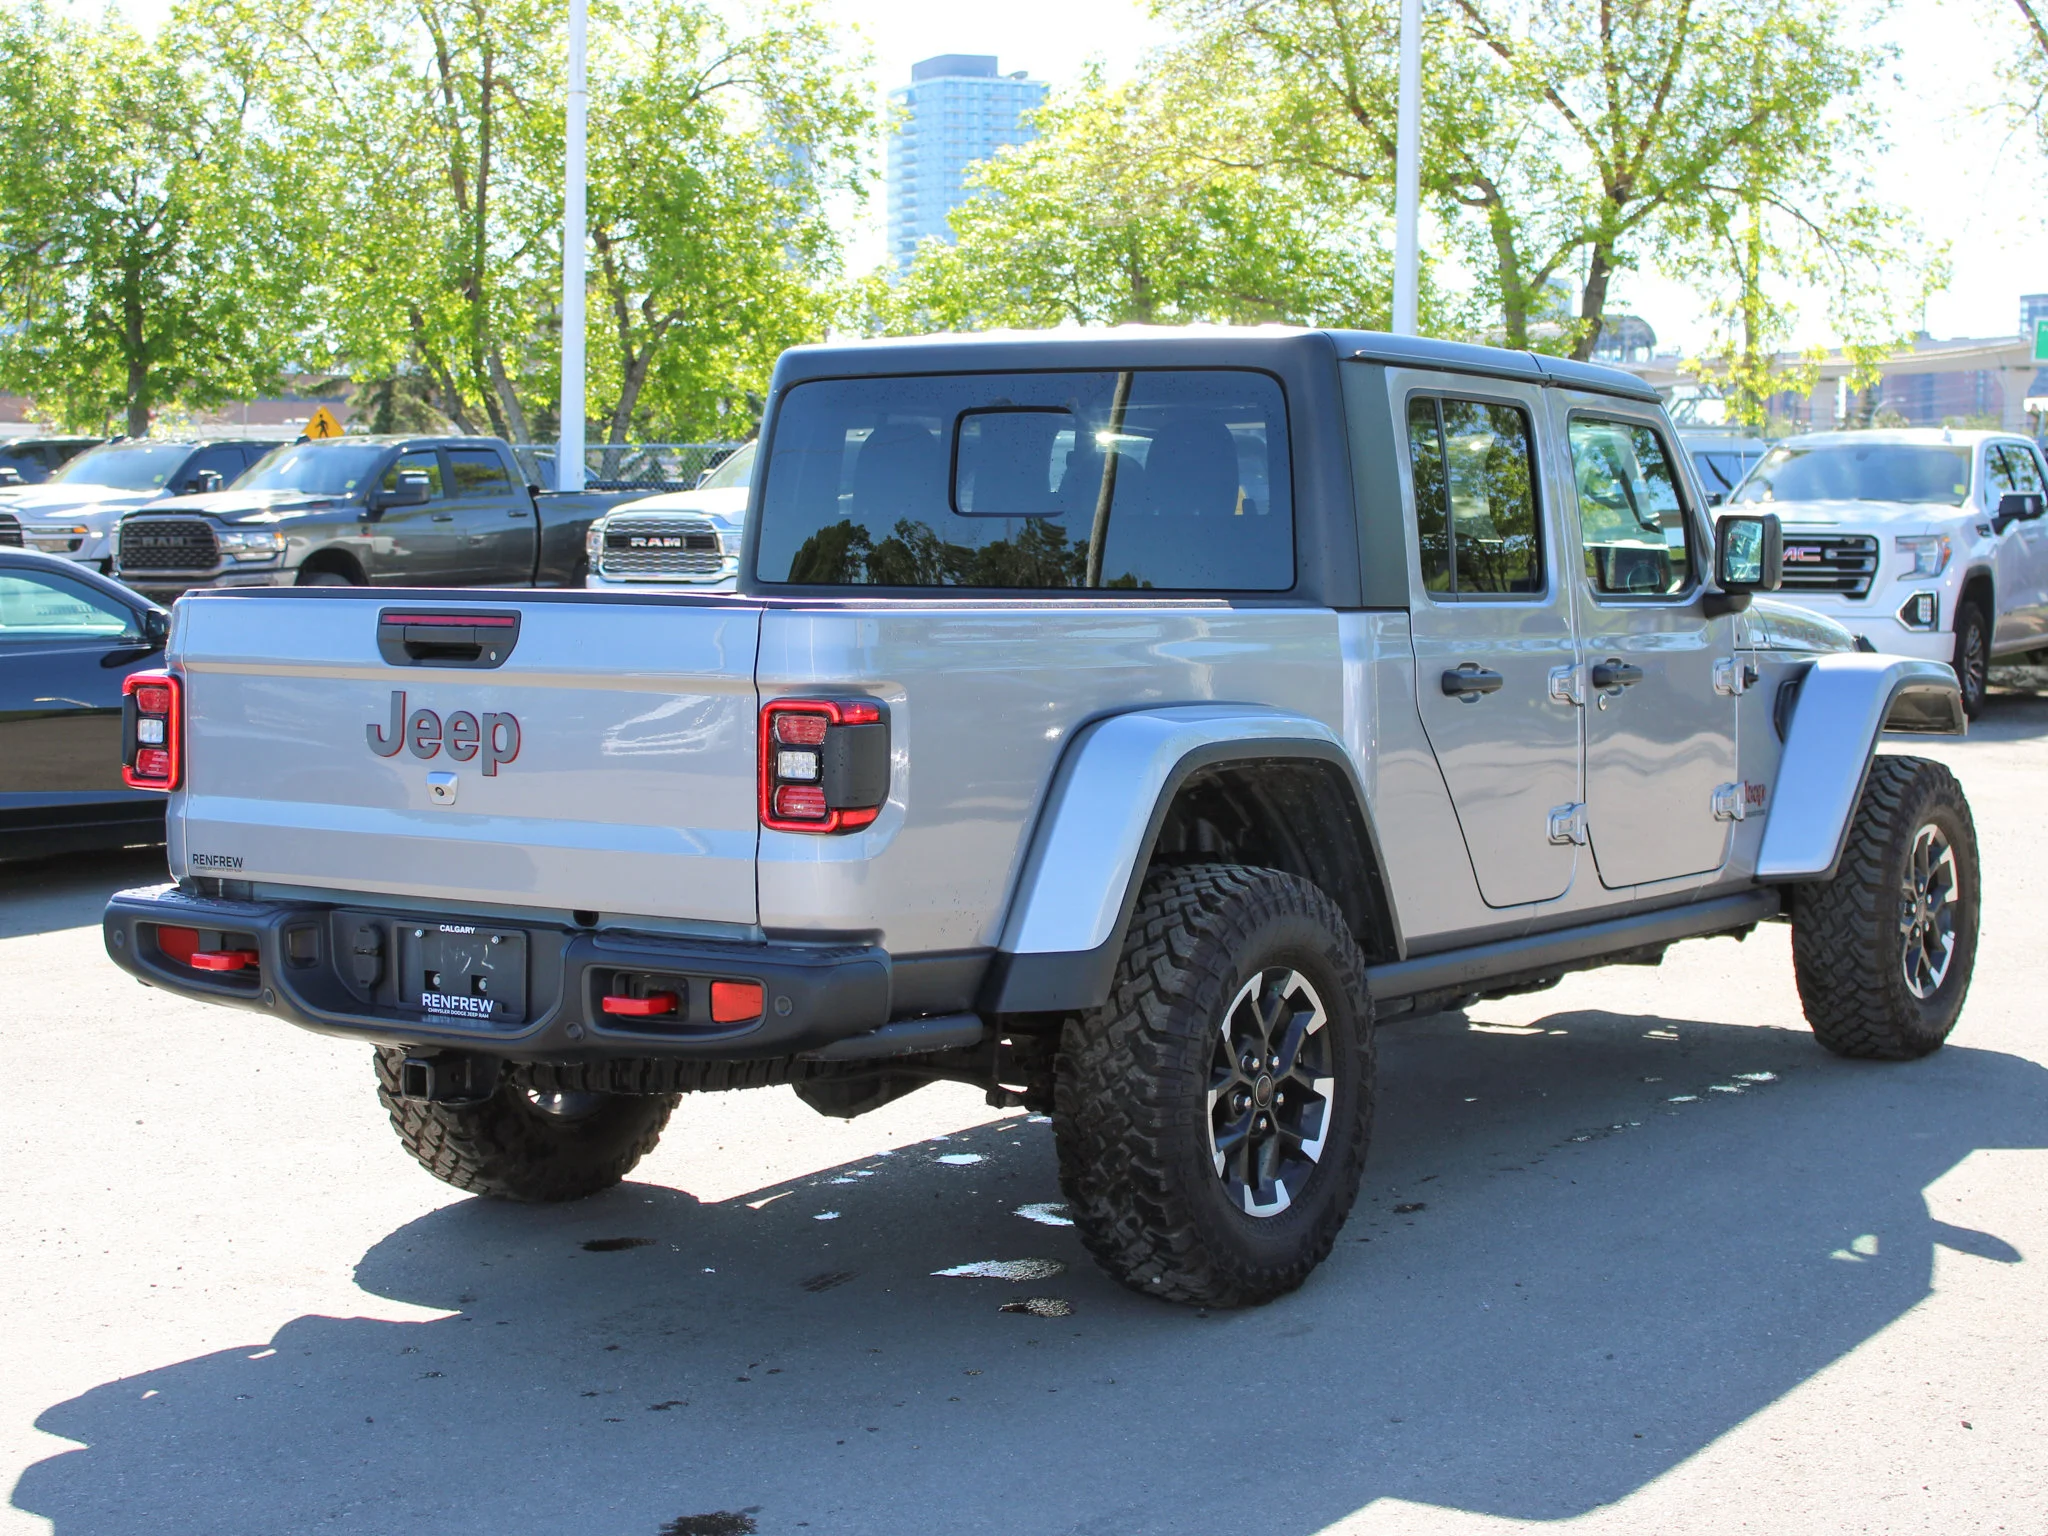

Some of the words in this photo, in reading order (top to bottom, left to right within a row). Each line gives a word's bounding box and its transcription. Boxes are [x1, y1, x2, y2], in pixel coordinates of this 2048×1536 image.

[141, 536, 184, 547] RAM
[630, 537, 681, 547] RAM
[366, 690, 521, 777] Jeep
[192, 853, 244, 868] RENFREW
[439, 924, 476, 935] CALGARY
[421, 992, 494, 1013] RENFREW
